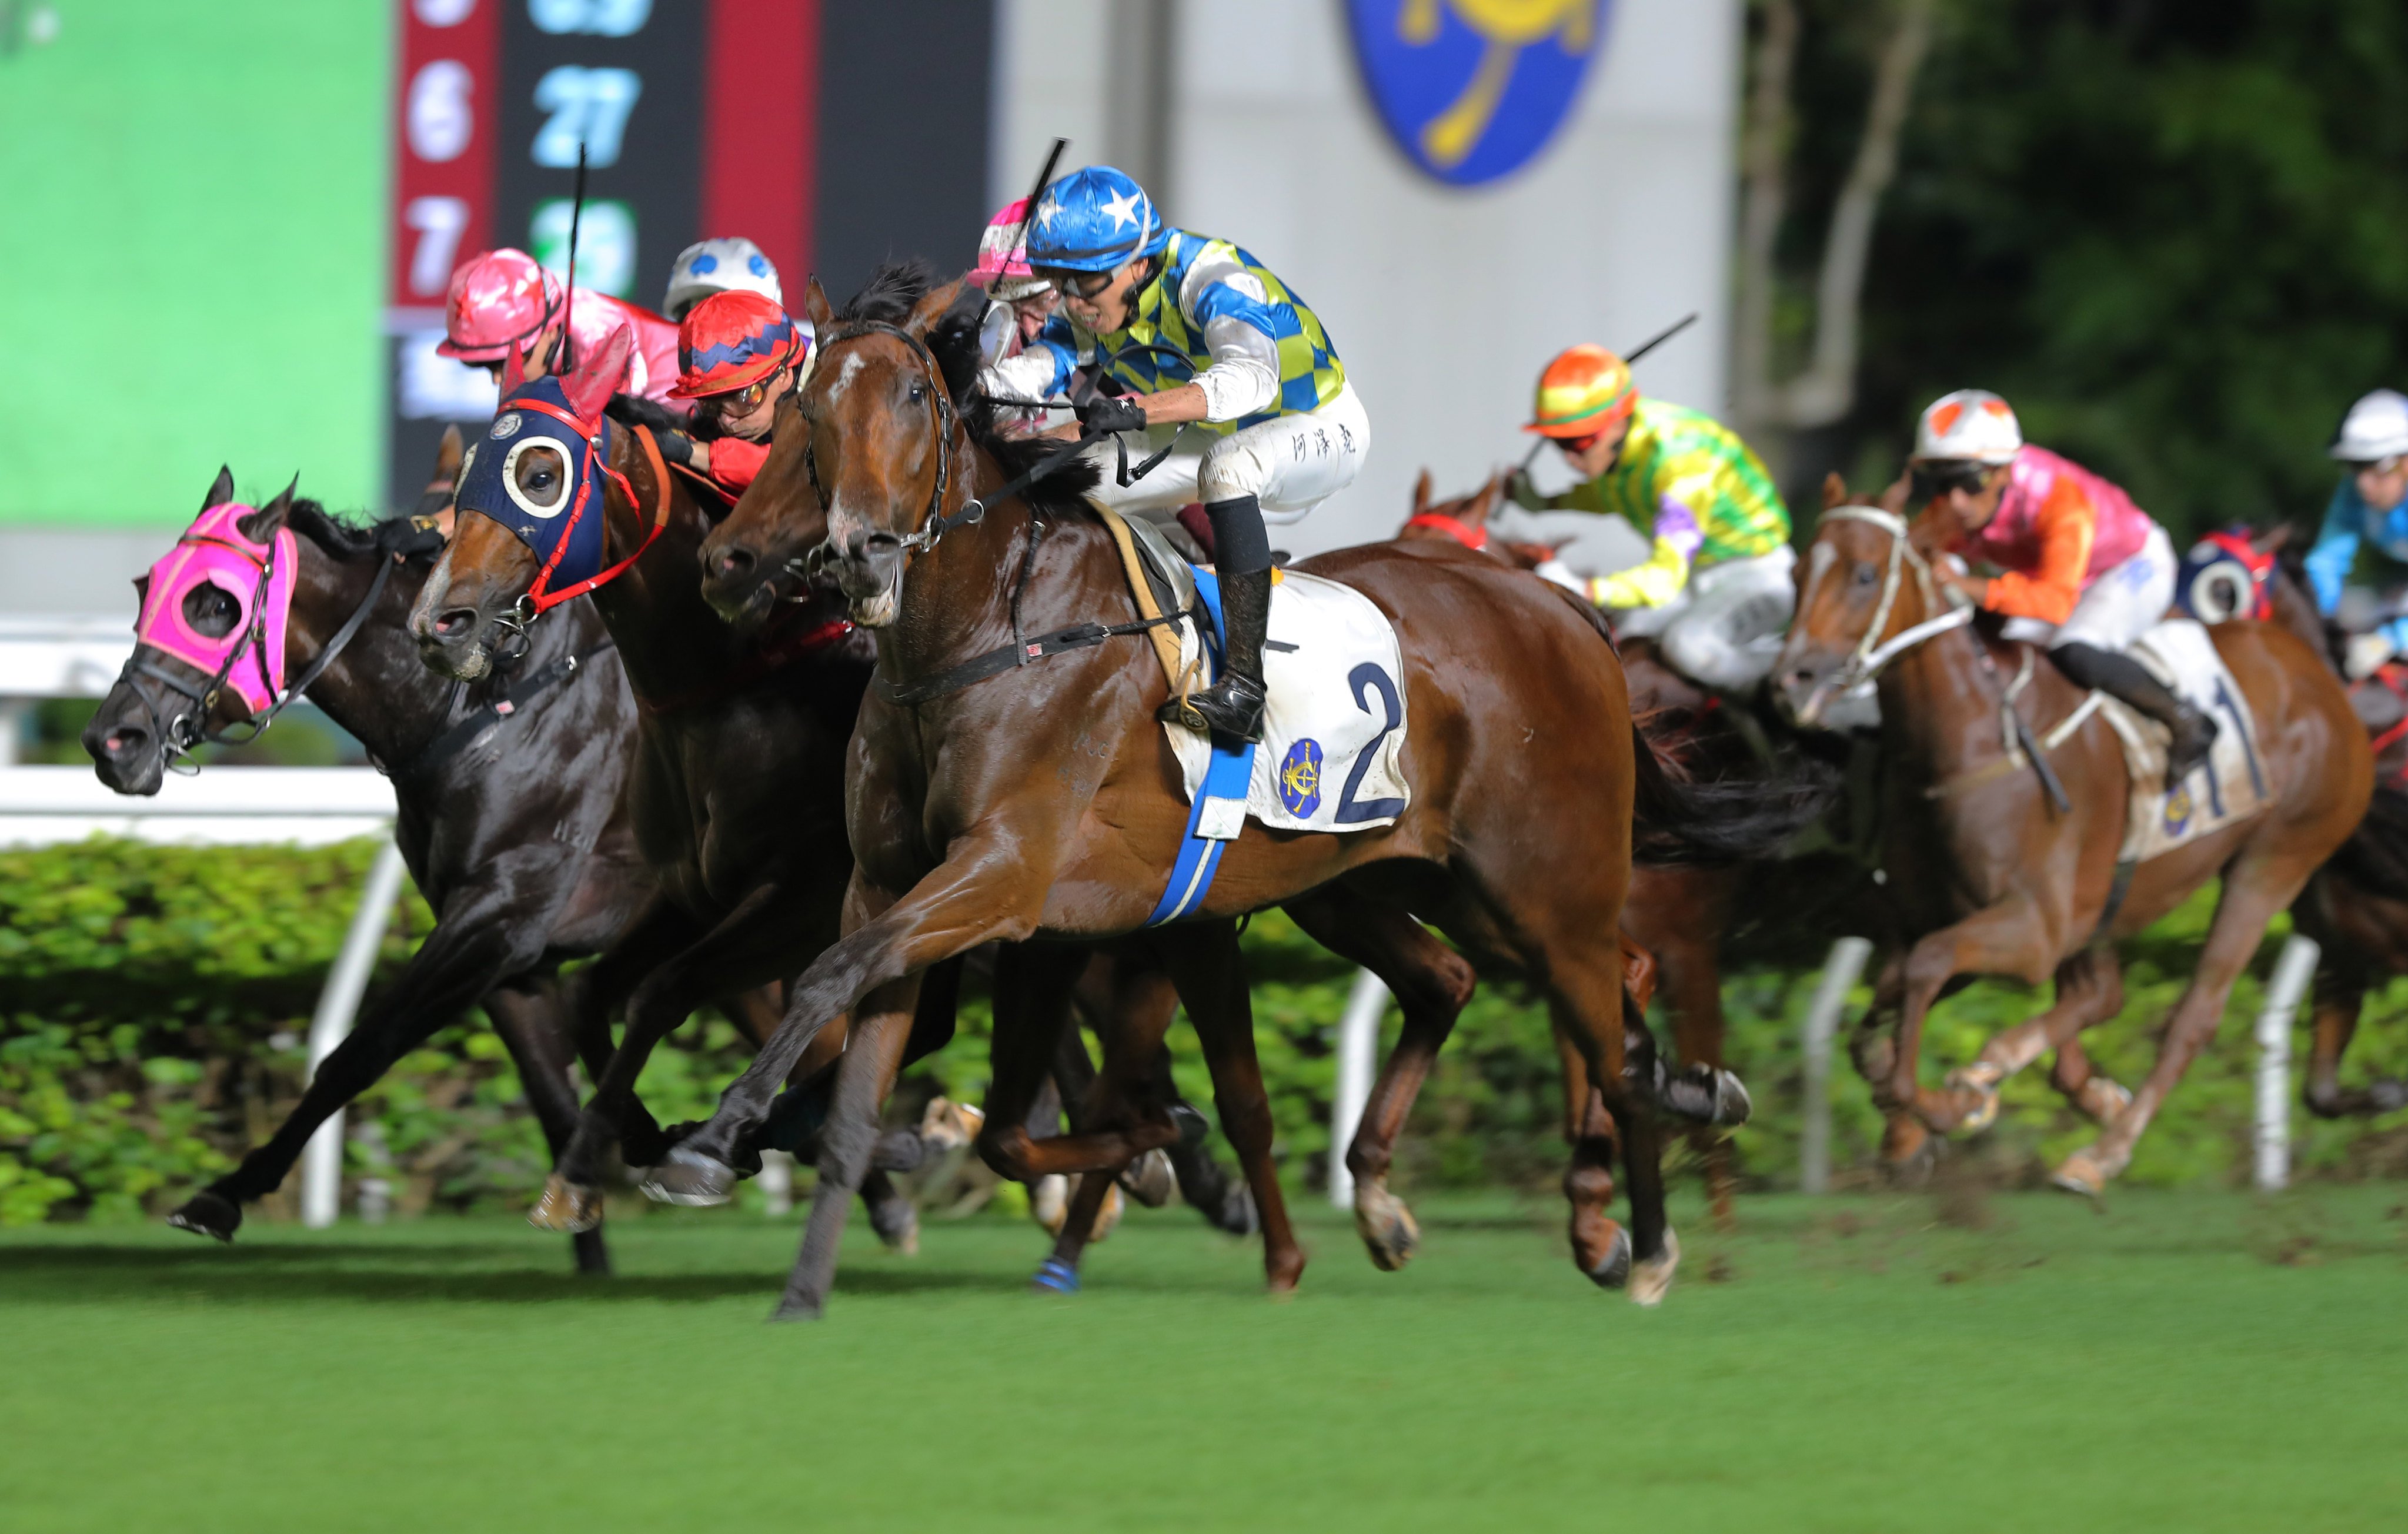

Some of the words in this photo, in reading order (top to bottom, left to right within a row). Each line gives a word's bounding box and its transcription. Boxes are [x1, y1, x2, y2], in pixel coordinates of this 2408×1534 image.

[409, 60, 473, 162] 6
[532, 65, 643, 168] 27
[407, 196, 468, 296] 7
[1334, 662, 1405, 823] 2
